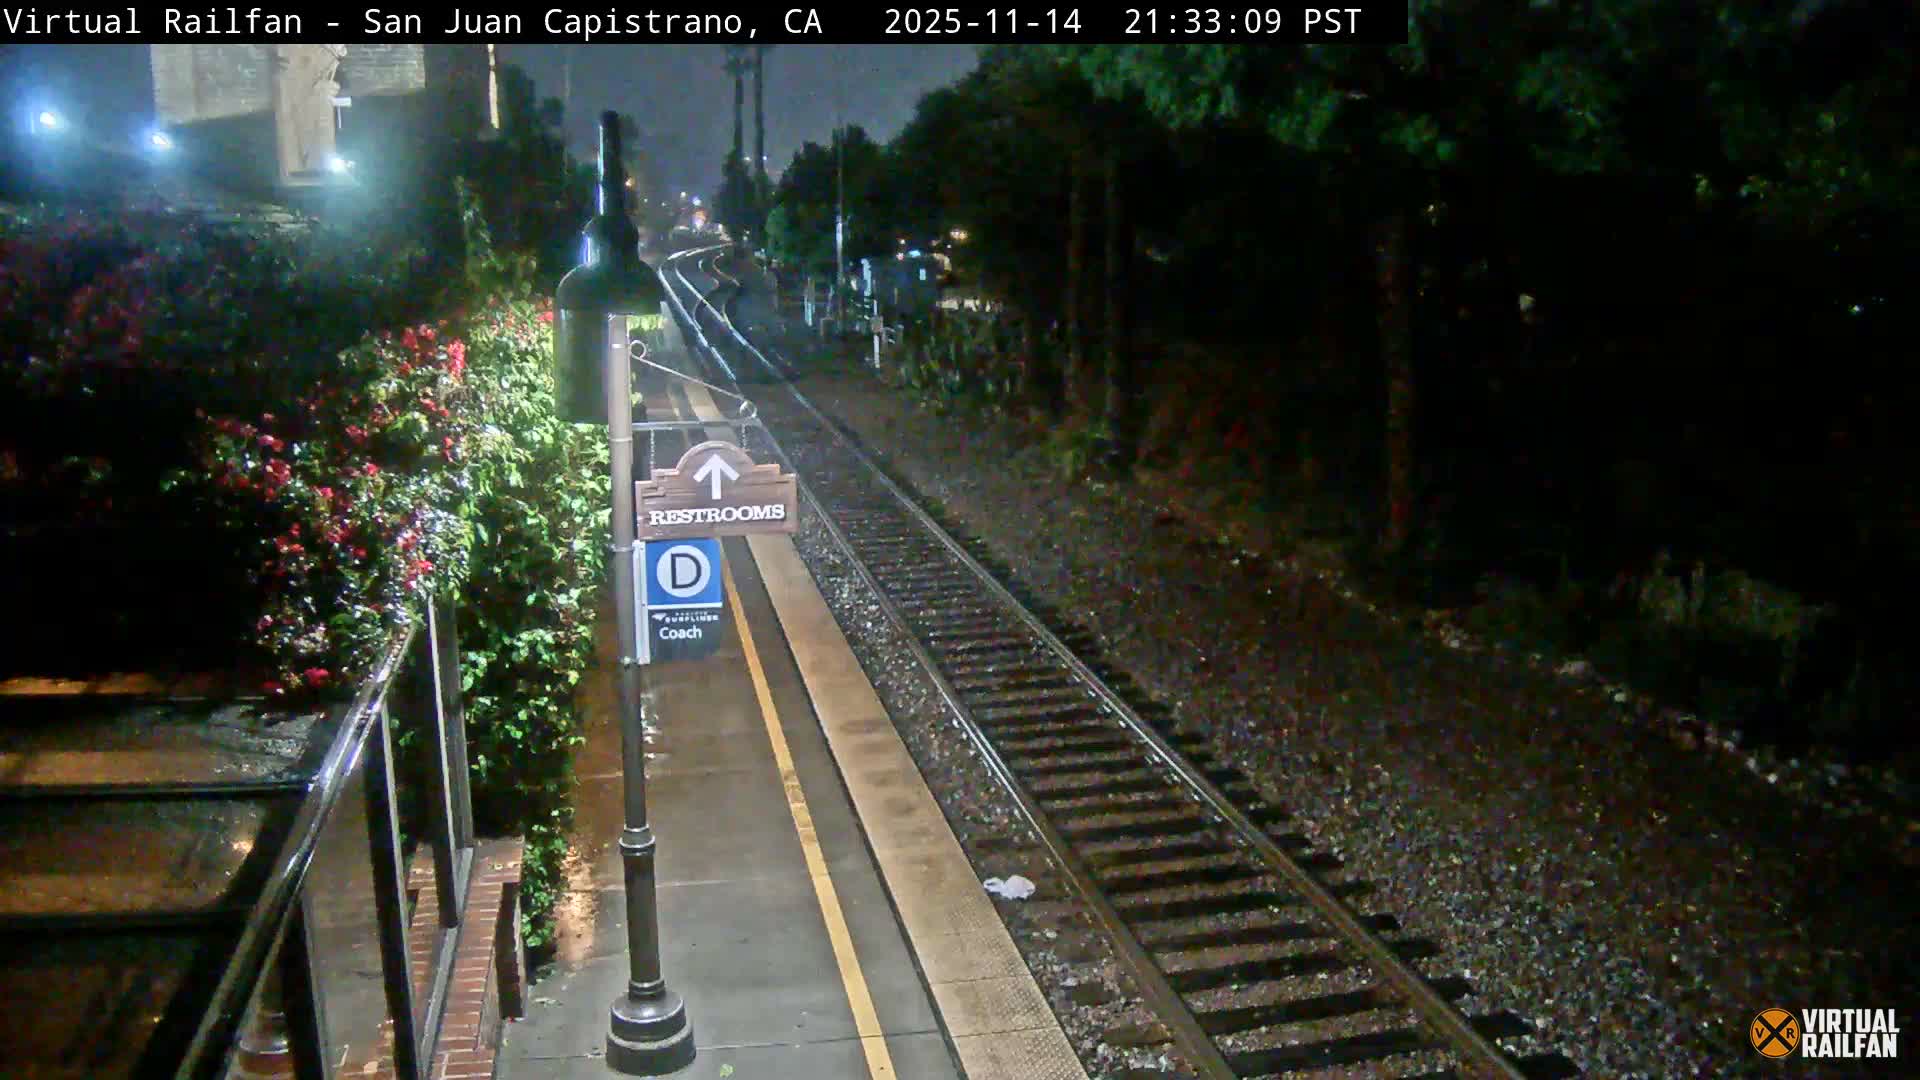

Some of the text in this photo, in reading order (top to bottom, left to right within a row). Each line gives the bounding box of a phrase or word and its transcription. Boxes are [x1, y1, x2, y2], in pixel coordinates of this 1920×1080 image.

[648, 504, 786, 526] RESTROOMS
[670, 552, 702, 589] D
[659, 624, 703, 640] Coach
